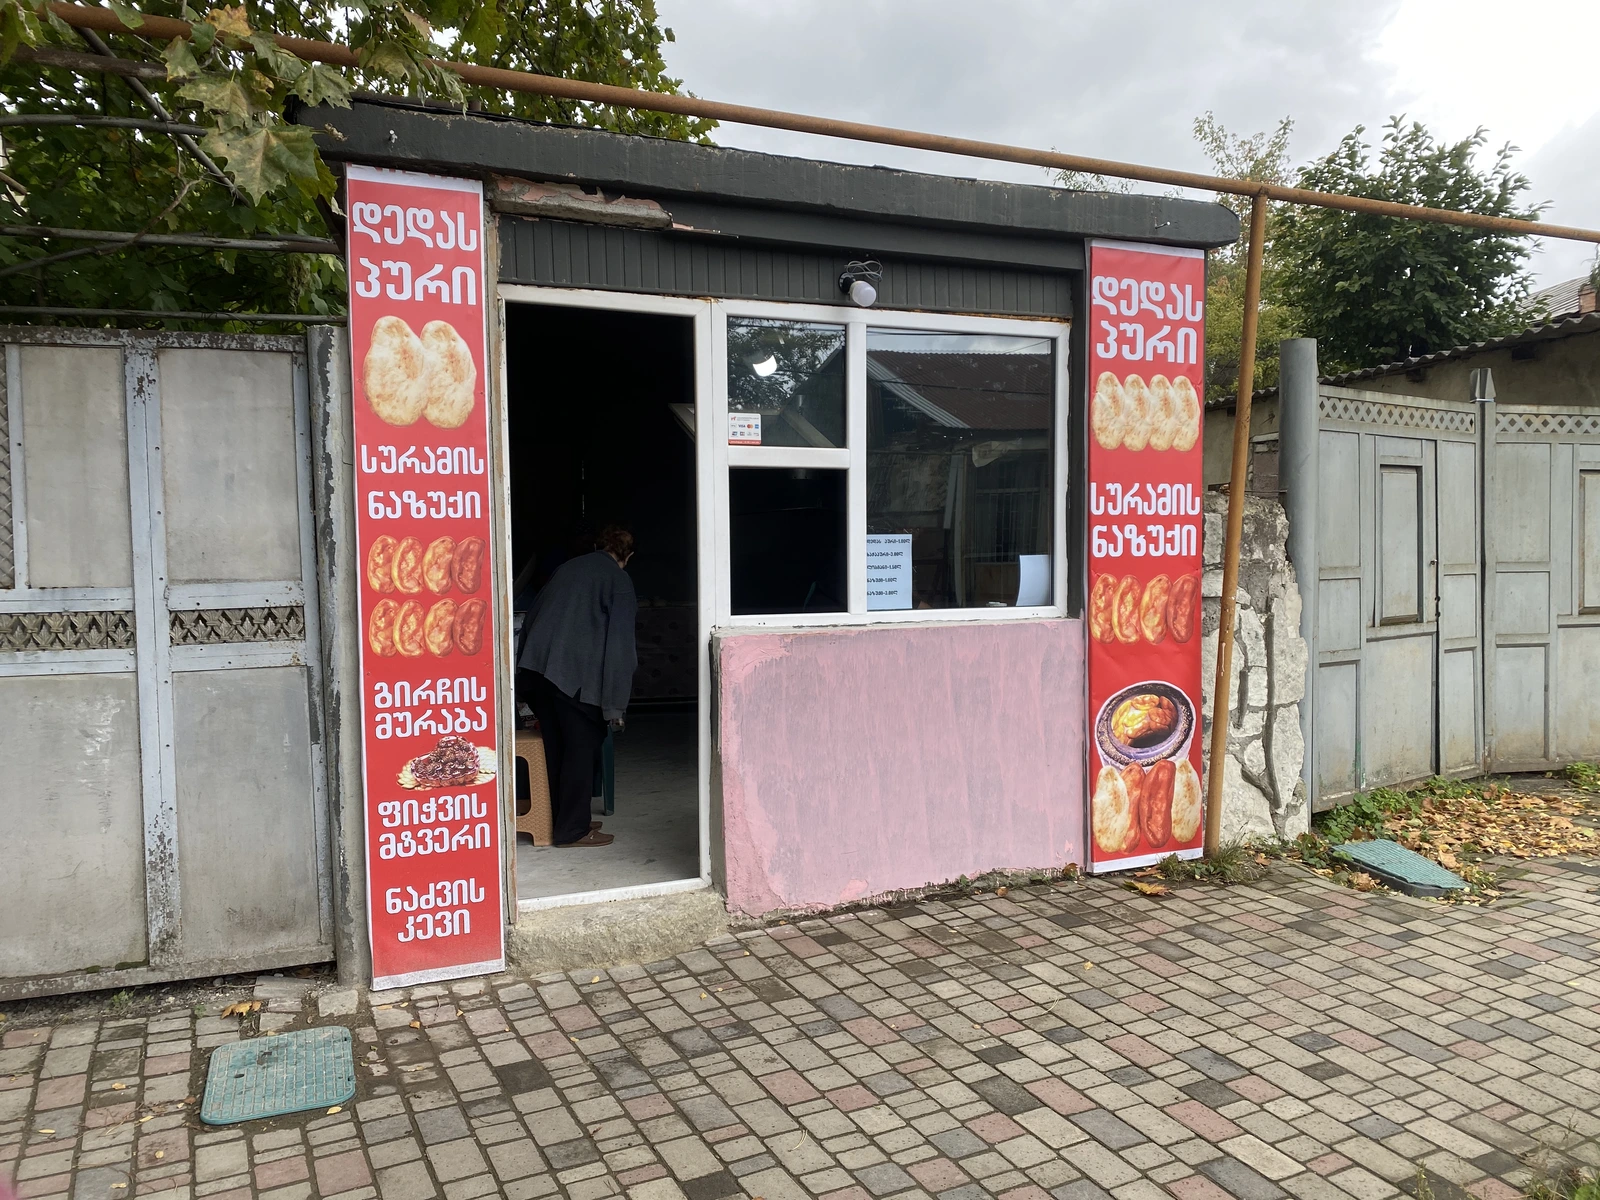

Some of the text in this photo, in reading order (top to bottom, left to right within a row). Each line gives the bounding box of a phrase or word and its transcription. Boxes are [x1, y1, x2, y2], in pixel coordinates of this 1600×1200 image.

[352, 201, 478, 252] დედას
[355, 257, 477, 306] პური
[1091, 275, 1203, 323] დედას
[1096, 319, 1198, 365] პური
[360, 444, 485, 475] სურამის
[367, 490, 481, 520] ნაზუქი
[1090, 482, 1201, 516] სურამის
[1092, 523, 1197, 558] ნაზუქი
[374, 676, 487, 709] გირჩის
[374, 705, 488, 740] მურაბა
[377, 792, 487, 828] ფიჭვის
[378, 822, 491, 860] მტვერი
[385, 877, 485, 915] ნაძვის
[397, 908, 471, 943] კევი
